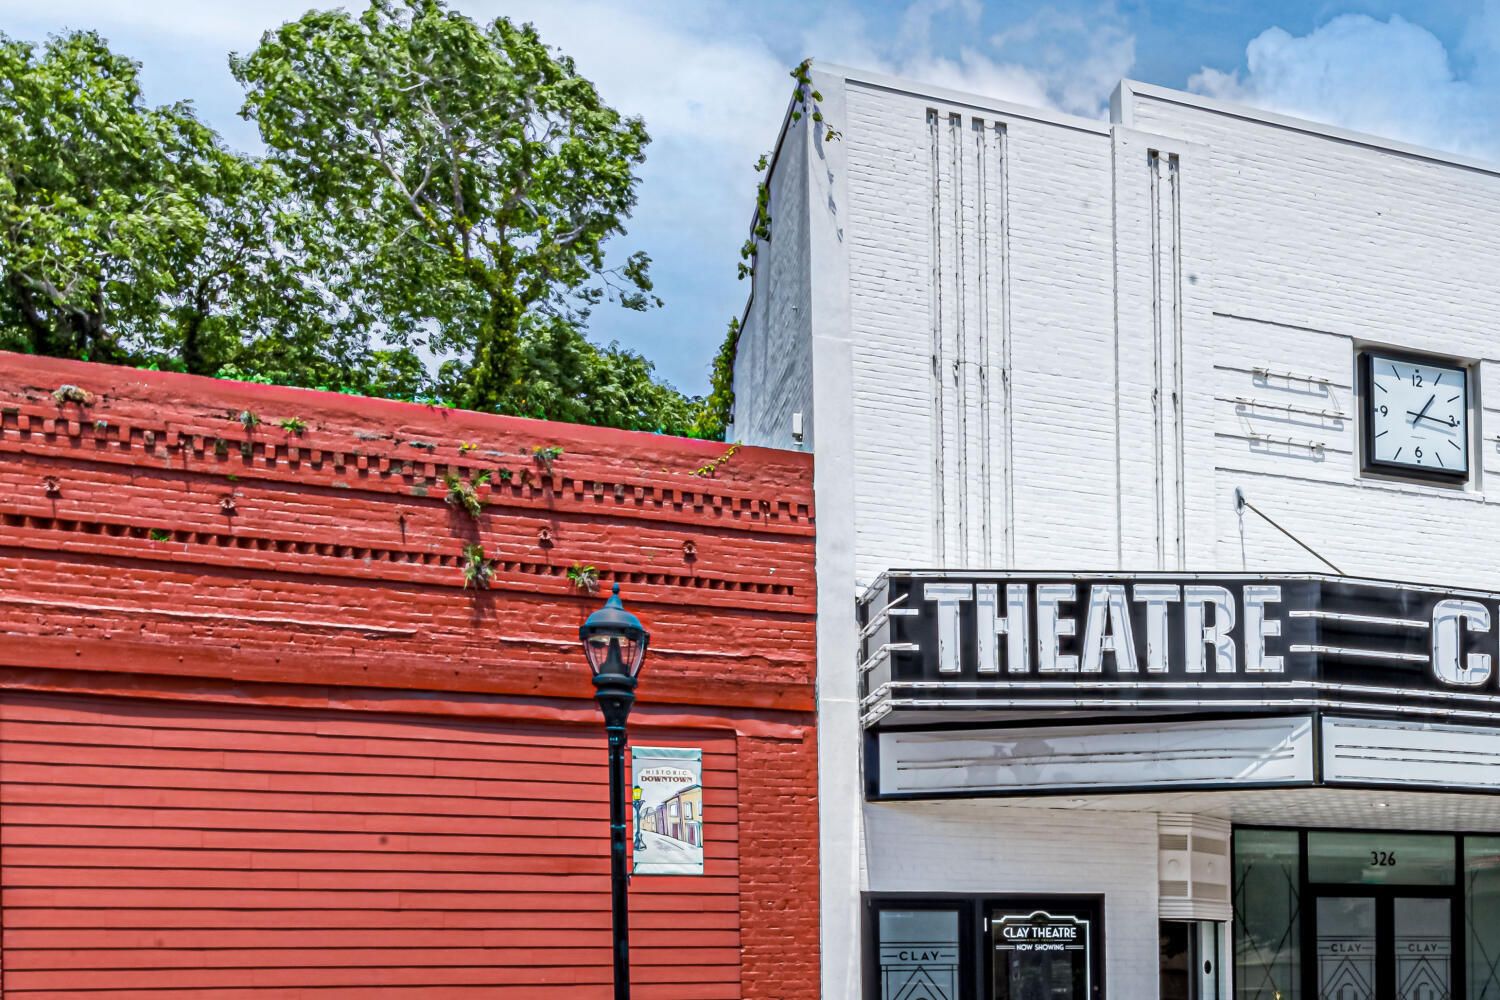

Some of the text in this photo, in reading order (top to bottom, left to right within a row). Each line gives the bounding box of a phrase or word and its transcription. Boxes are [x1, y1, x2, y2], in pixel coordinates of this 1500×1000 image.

[1412, 374, 1423, 387] 12
[1380, 405, 1388, 417] 9
[1448, 415, 1456, 428] 3
[1414, 446, 1423, 458] 6
[924, 583, 1284, 673] THEATRE
[641, 775, 693, 783] DOWNTOWN
[1371, 851, 1396, 866] 326
[1003, 927, 1077, 938] CLAY THEATRE
[1330, 943, 1362, 952] CLAY
[1407, 943, 1438, 952] CLAY
[899, 951, 939, 961] CLAY
